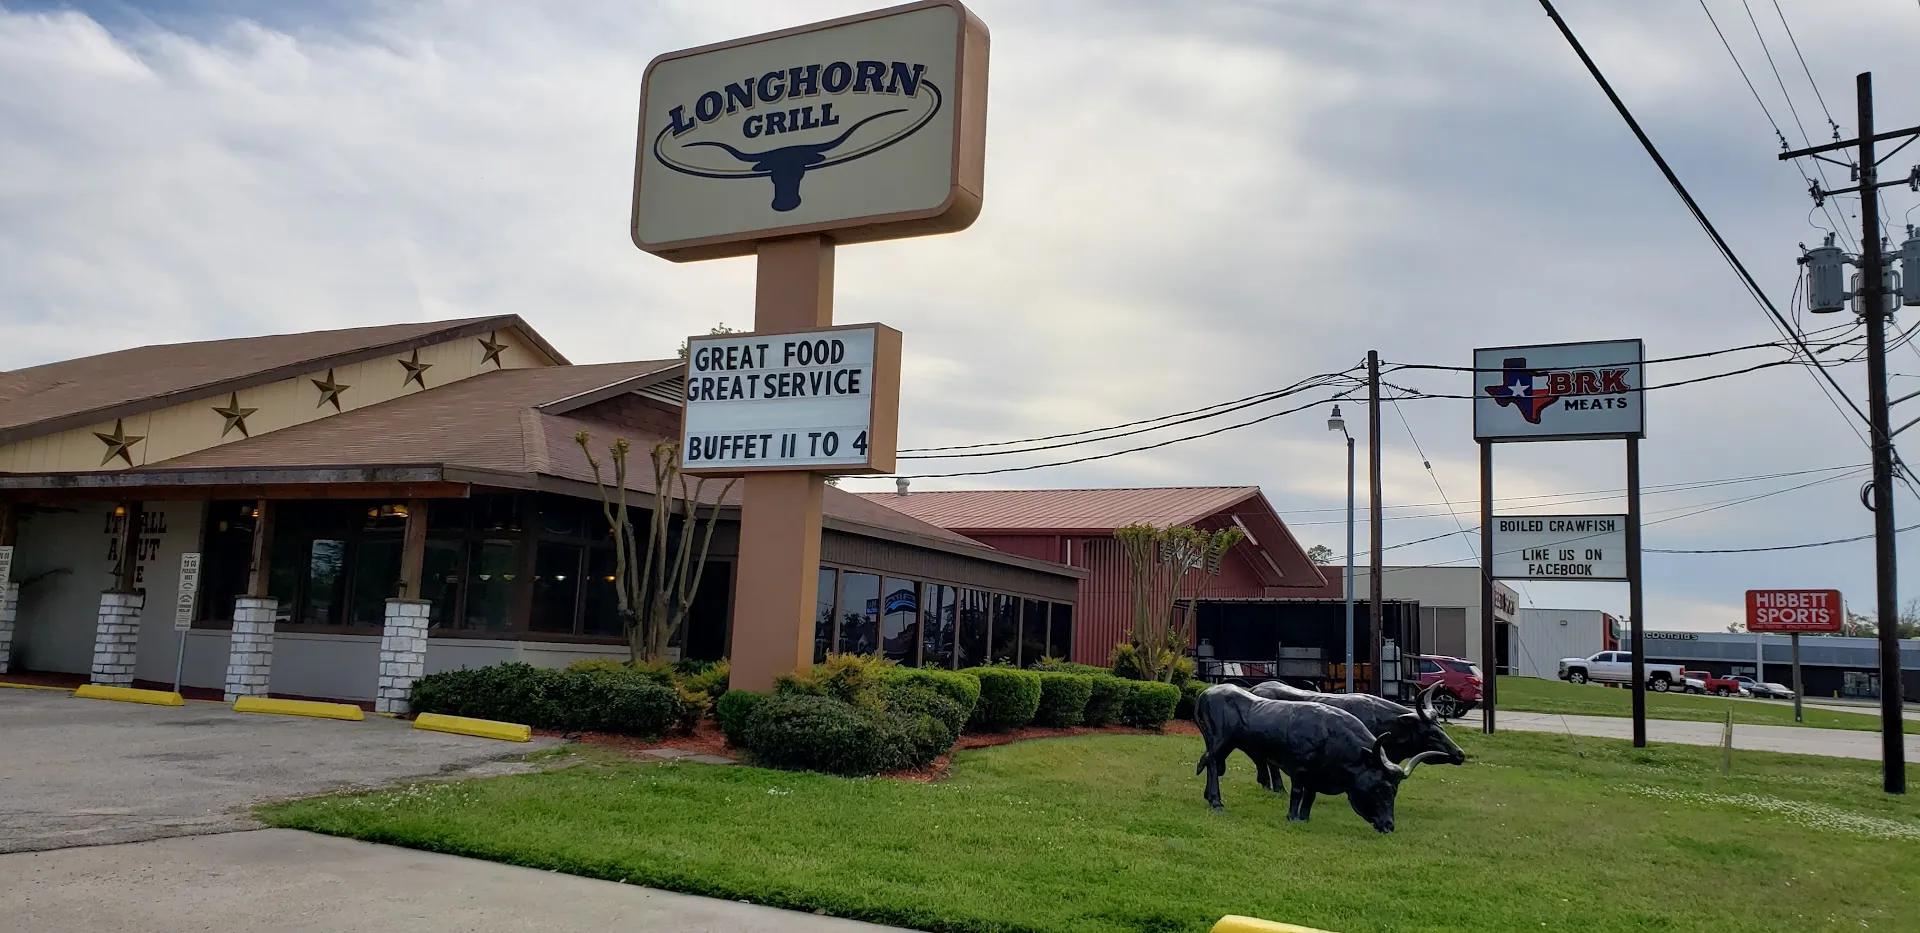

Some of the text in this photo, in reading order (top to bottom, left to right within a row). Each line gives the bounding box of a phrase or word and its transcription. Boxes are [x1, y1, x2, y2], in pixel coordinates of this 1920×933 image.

[668, 60, 926, 139] LONGHORN
[743, 103, 840, 138] GRILL
[695, 340, 844, 371] GREAT FOOD
[687, 369, 861, 401] GREAT SERVICE
[1547, 368, 1630, 395] BRK
[1564, 397, 1627, 411] MEATS
[688, 434, 772, 461] BUFFET
[808, 431, 838, 456] TO
[852, 430, 867, 456] 4
[1500, 520, 1615, 532] BOILED CRAWFISH
[107, 538, 160, 561] AUT
[1522, 549, 1602, 560] LIKE US ON
[1528, 564, 1592, 575] FACEBOOK
[1756, 592, 1828, 607] HIBBETT
[1757, 608, 1830, 623] SPORTS
